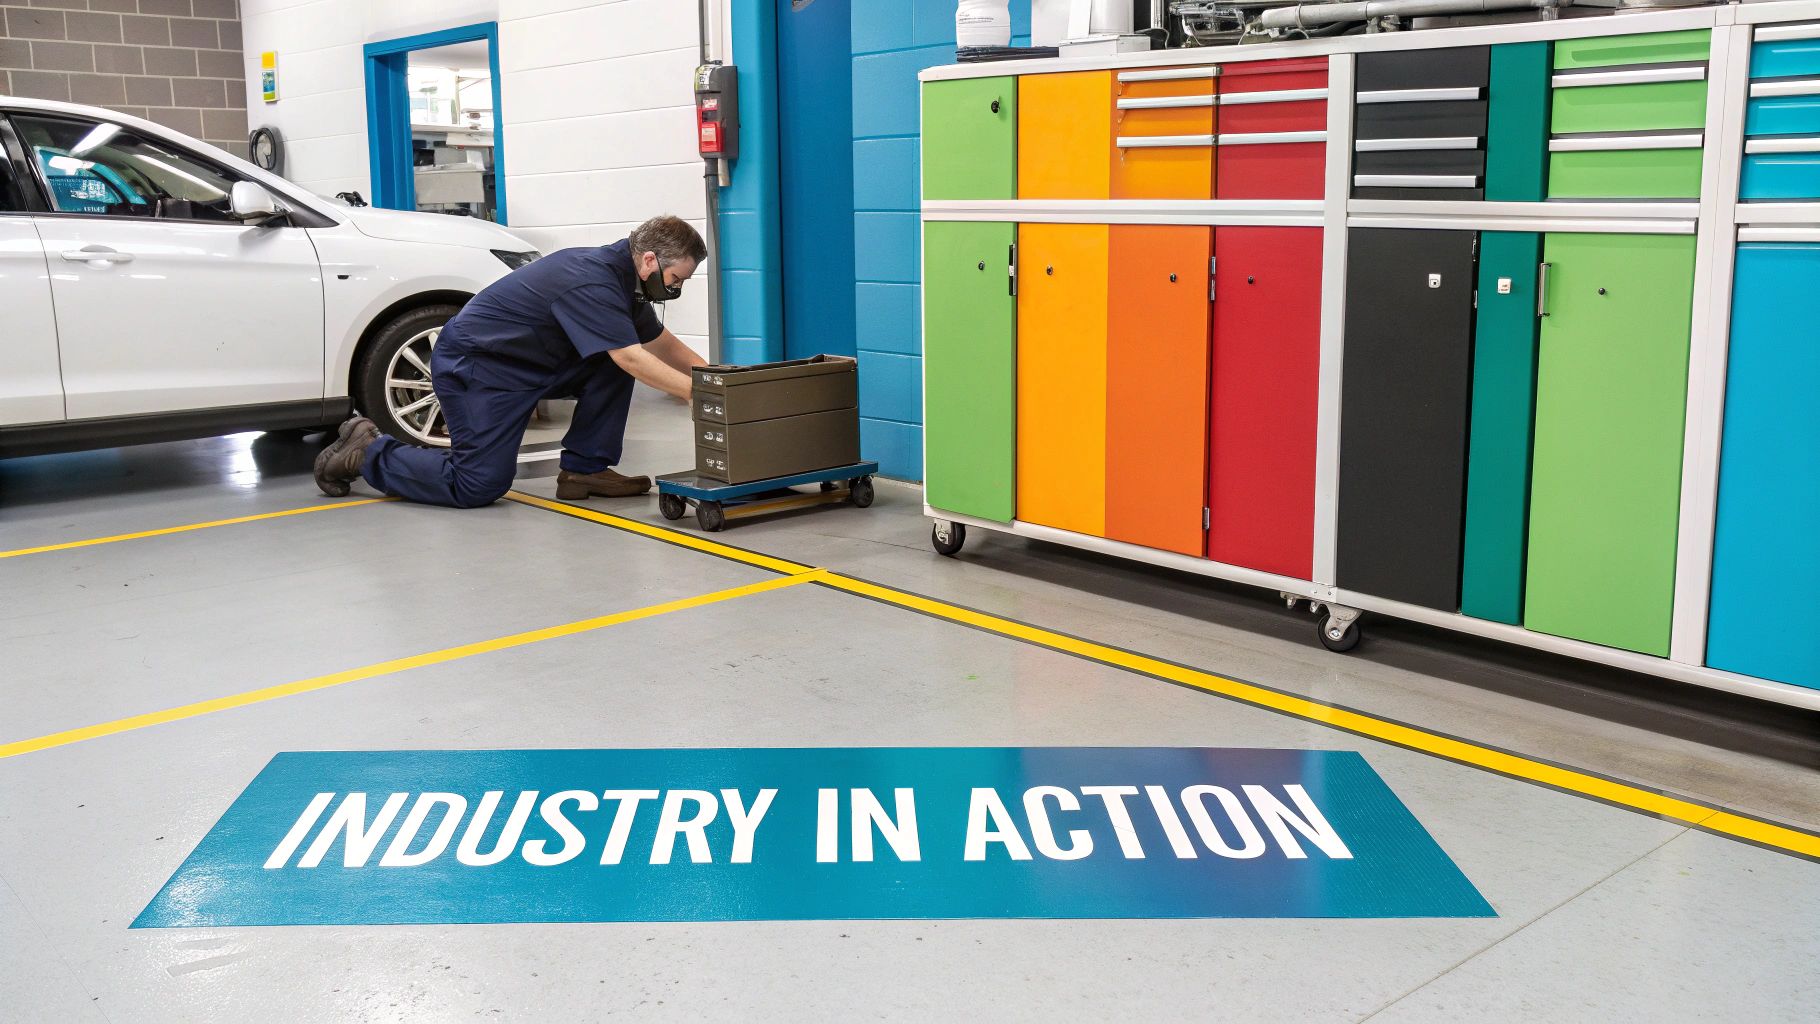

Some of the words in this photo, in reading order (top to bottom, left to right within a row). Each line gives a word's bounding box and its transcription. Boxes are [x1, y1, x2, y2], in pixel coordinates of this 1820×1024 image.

[262, 788, 779, 870] INDUSTRY
[816, 787, 921, 862] IN
[964, 783, 1354, 861] ACTION
